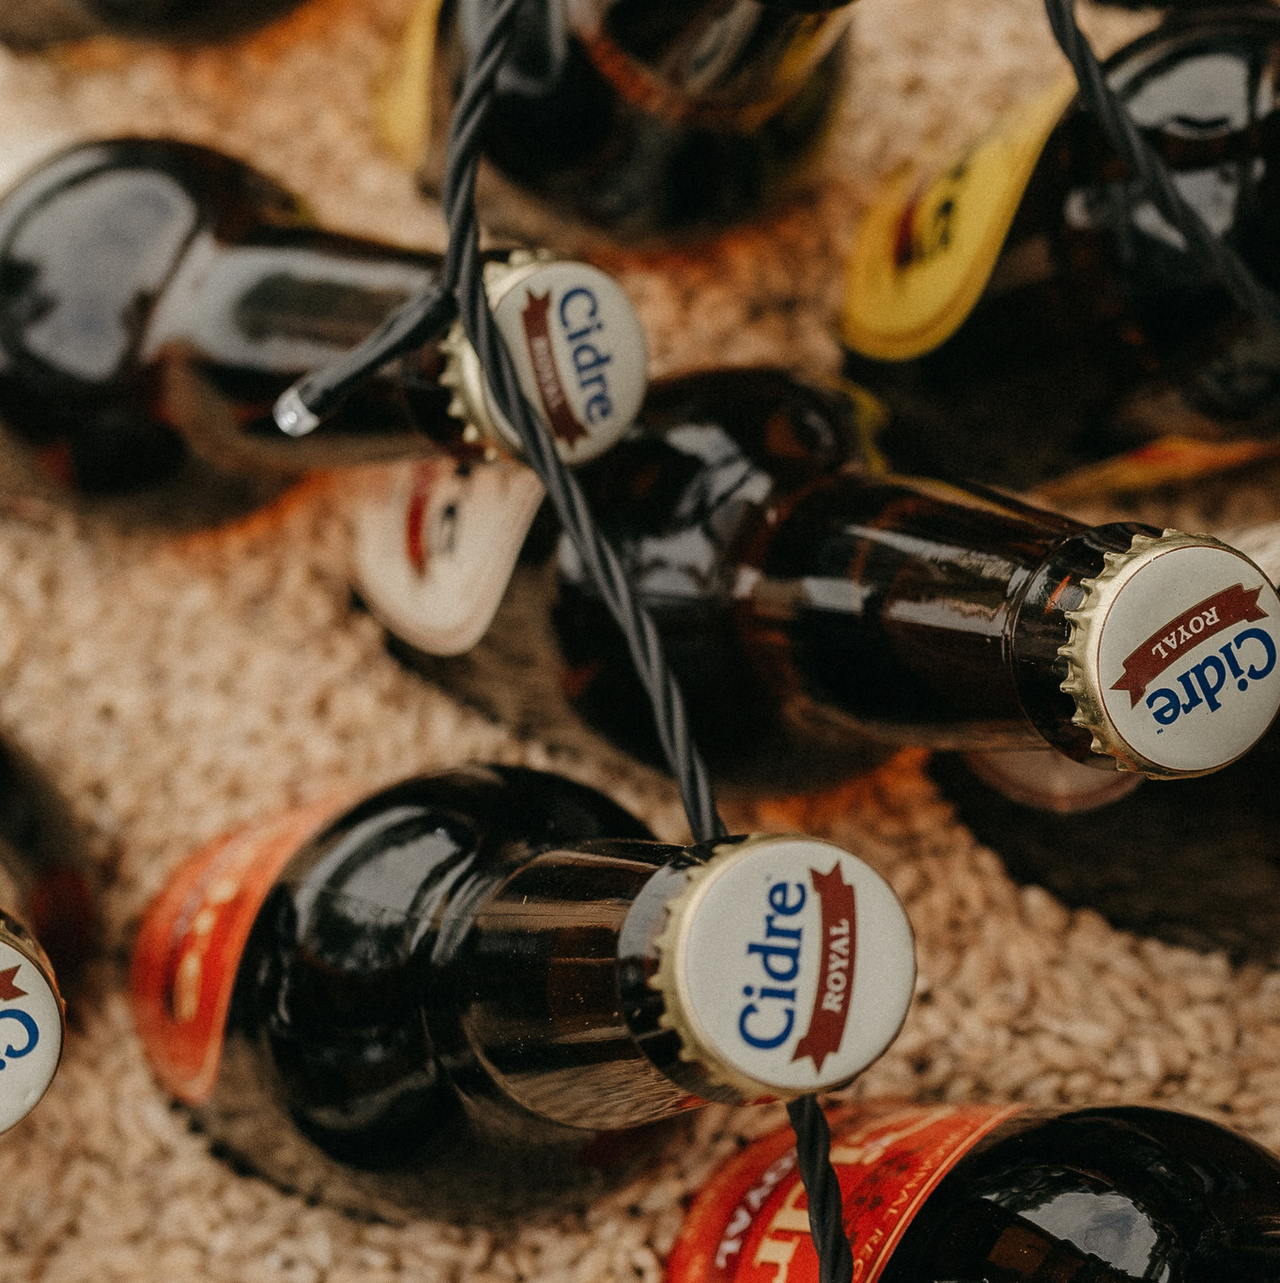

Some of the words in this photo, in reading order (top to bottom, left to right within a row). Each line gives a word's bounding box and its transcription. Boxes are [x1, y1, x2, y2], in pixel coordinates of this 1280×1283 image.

[559, 286, 612, 424] Cidre
[1145, 627, 1277, 726] Cidre
[1152, 606, 1221, 659] ROYAL
[739, 880, 807, 1050] Cidre
[821, 918, 850, 1013] ROYAL
